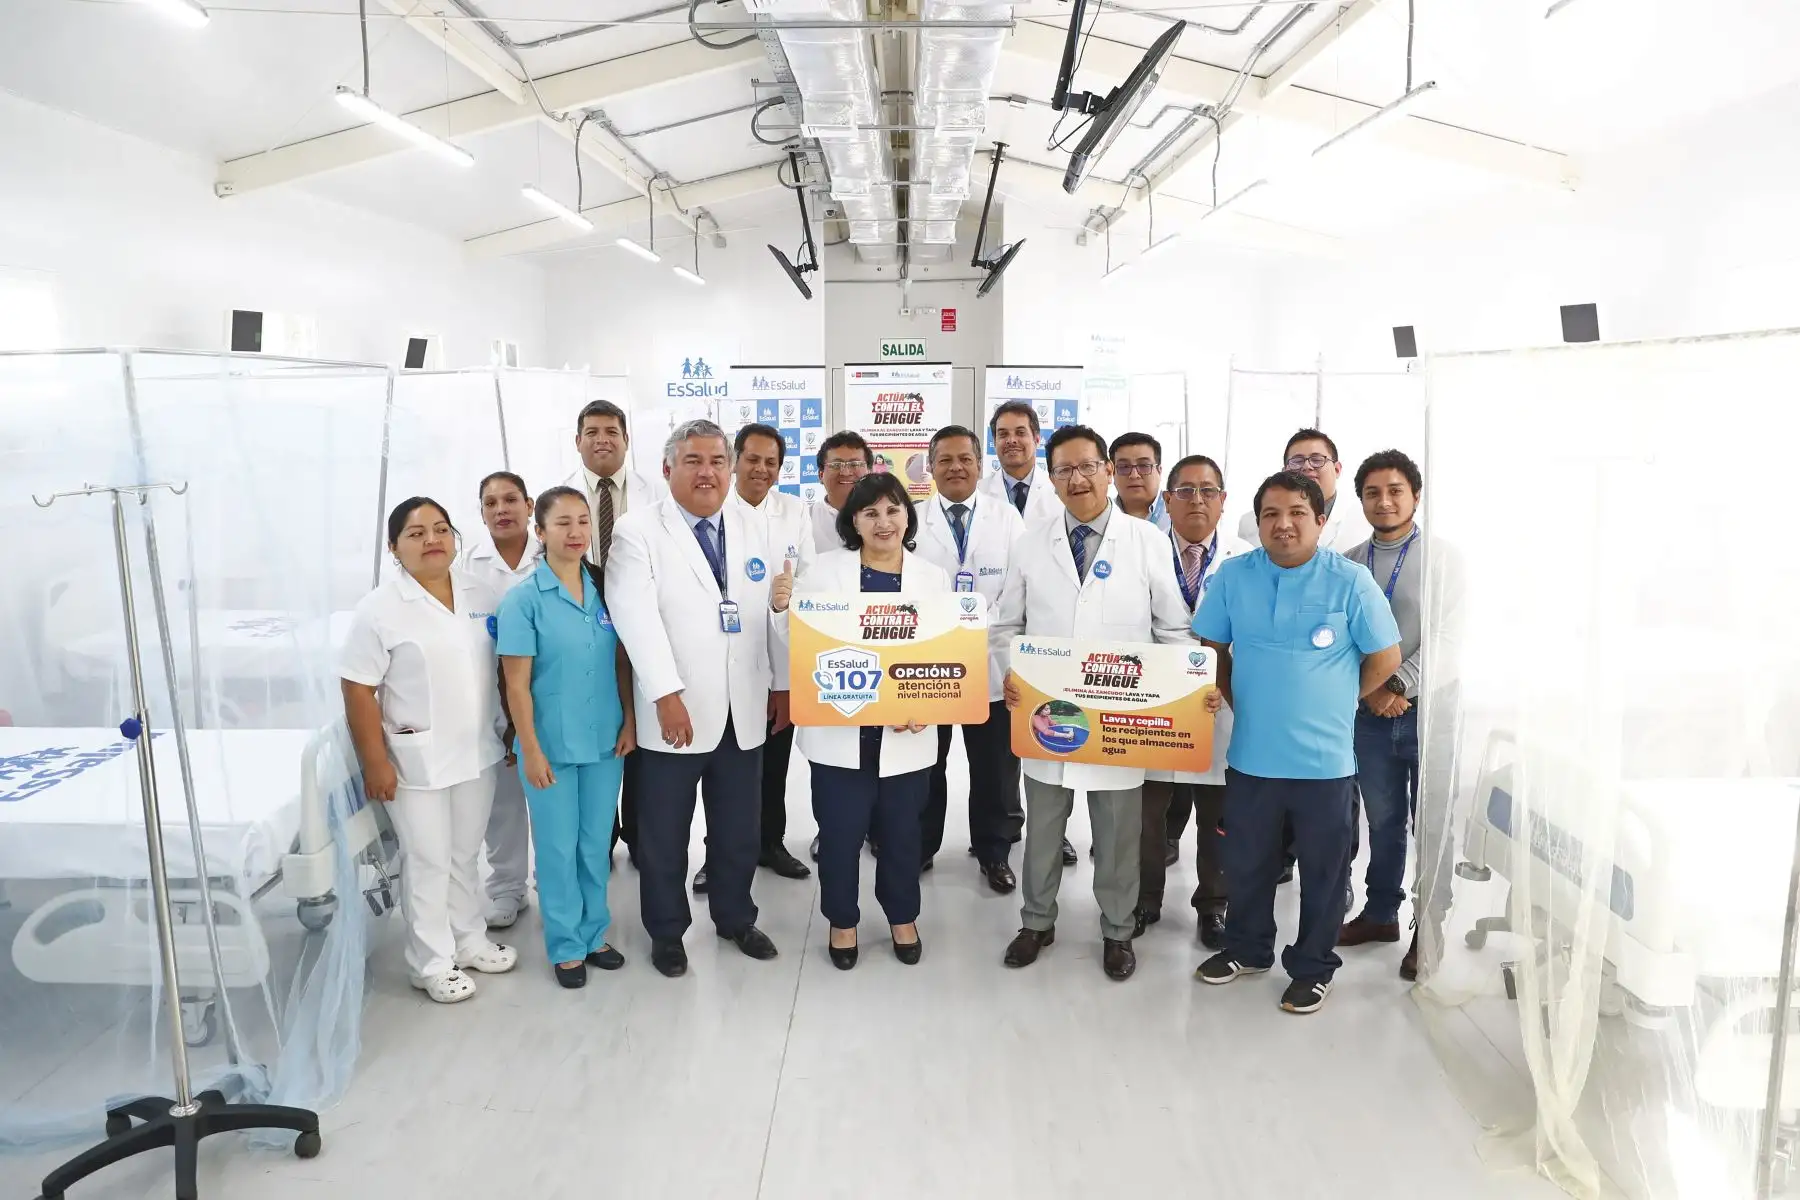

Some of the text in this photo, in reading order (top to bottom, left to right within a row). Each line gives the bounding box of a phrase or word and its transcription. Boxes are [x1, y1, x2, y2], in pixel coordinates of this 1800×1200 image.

[882, 343, 925, 356] SALIDA
[667, 381, 728, 397] EsSalud
[770, 380, 806, 391] EsSalud
[1025, 379, 1061, 391] EsSalud
[877, 392, 906, 402] ACTÚA
[875, 402, 922, 412] CONTRA EL
[873, 412, 923, 425] DENGUE
[816, 602, 850, 612] EsSalud
[866, 603, 897, 615] ACTÚA
[862, 615, 915, 626] CONTRA EL
[862, 626, 917, 640] DENGUE
[1037, 647, 1072, 657] EsSalud
[1087, 652, 1121, 664] ACTÚA
[828, 659, 869, 669] EsSalud
[1084, 663, 1139, 676] CONTRA EL
[895, 664, 962, 679] OPCIÓN 5
[835, 670, 882, 690] 107
[898, 679, 960, 691] atención a
[1083, 673, 1140, 689] DENGUE
[823, 692, 841, 700] LÍNEA
[897, 690, 962, 699] nivel nacional
[1102, 714, 1170, 727] Lava y cepilla
[1102, 725, 1117, 733] los
[1118, 726, 1177, 738] recipientes
[1102, 734, 1195, 750] los que almacenas
[1101, 746, 1127, 756] agua
